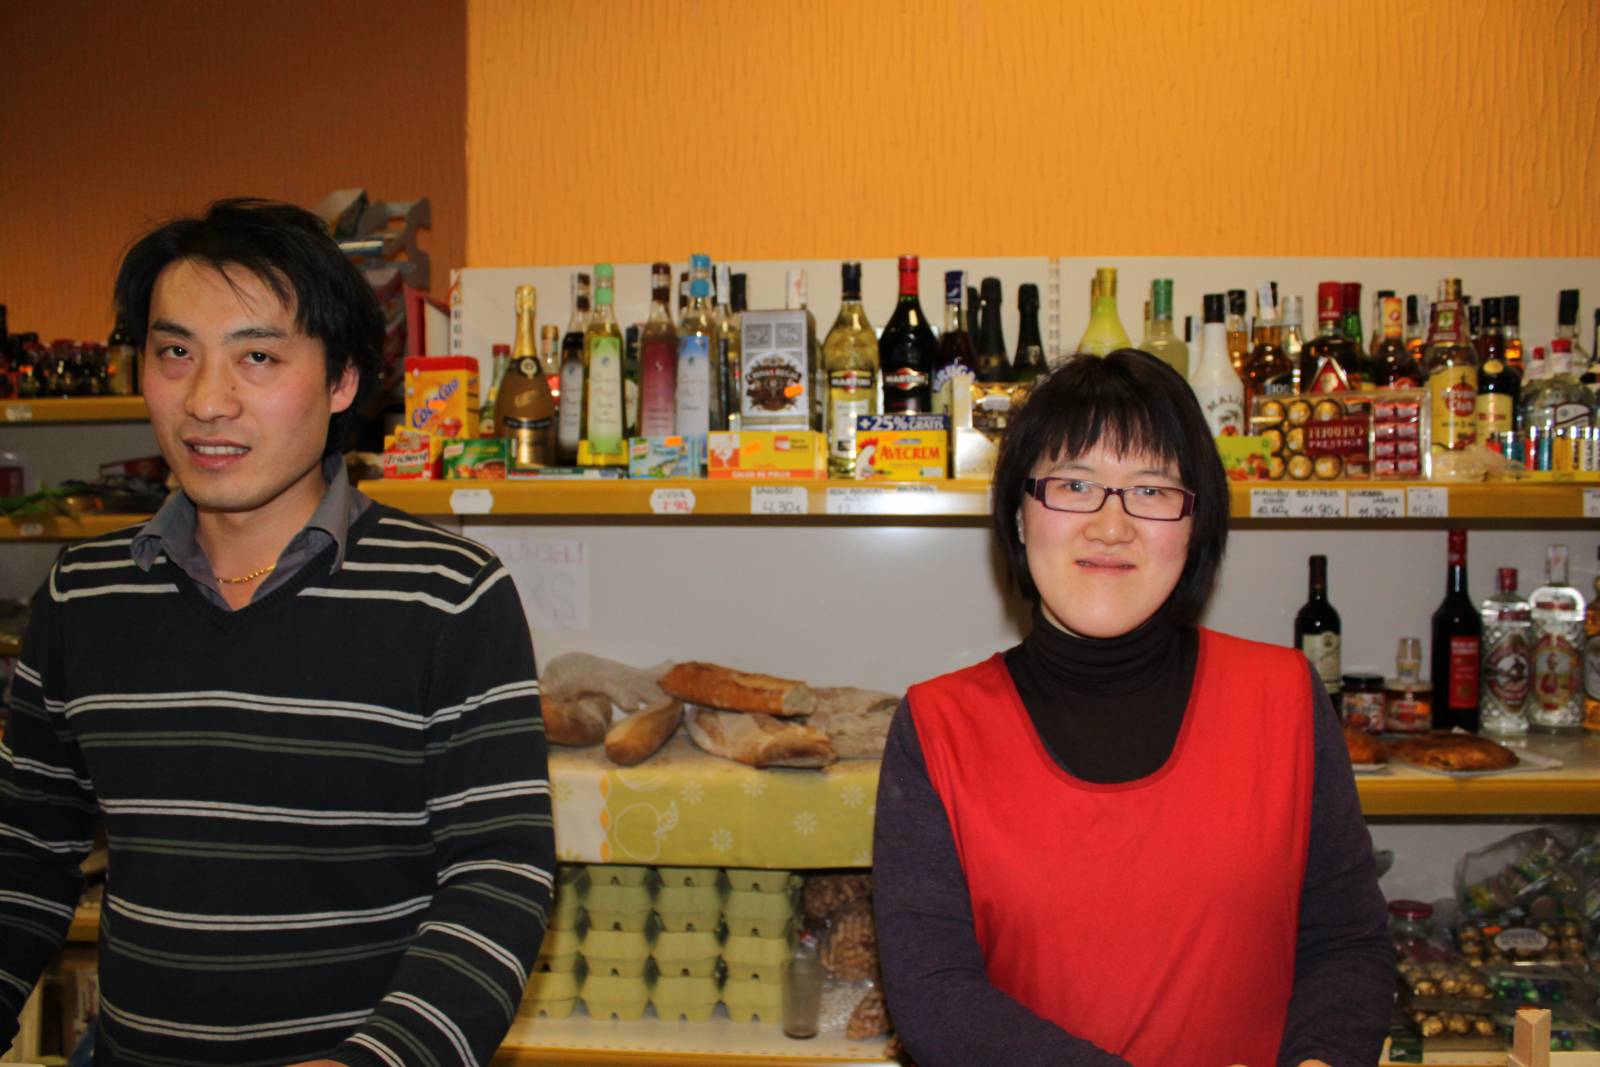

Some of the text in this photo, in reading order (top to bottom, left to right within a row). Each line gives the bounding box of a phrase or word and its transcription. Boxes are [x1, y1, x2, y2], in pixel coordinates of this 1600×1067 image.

[832, 379, 871, 387] MARTINI
[885, 375, 926, 385] MARTINI
[1309, 438, 1363, 448] PRESTIGE
[880, 445, 939, 460] AVECREM
